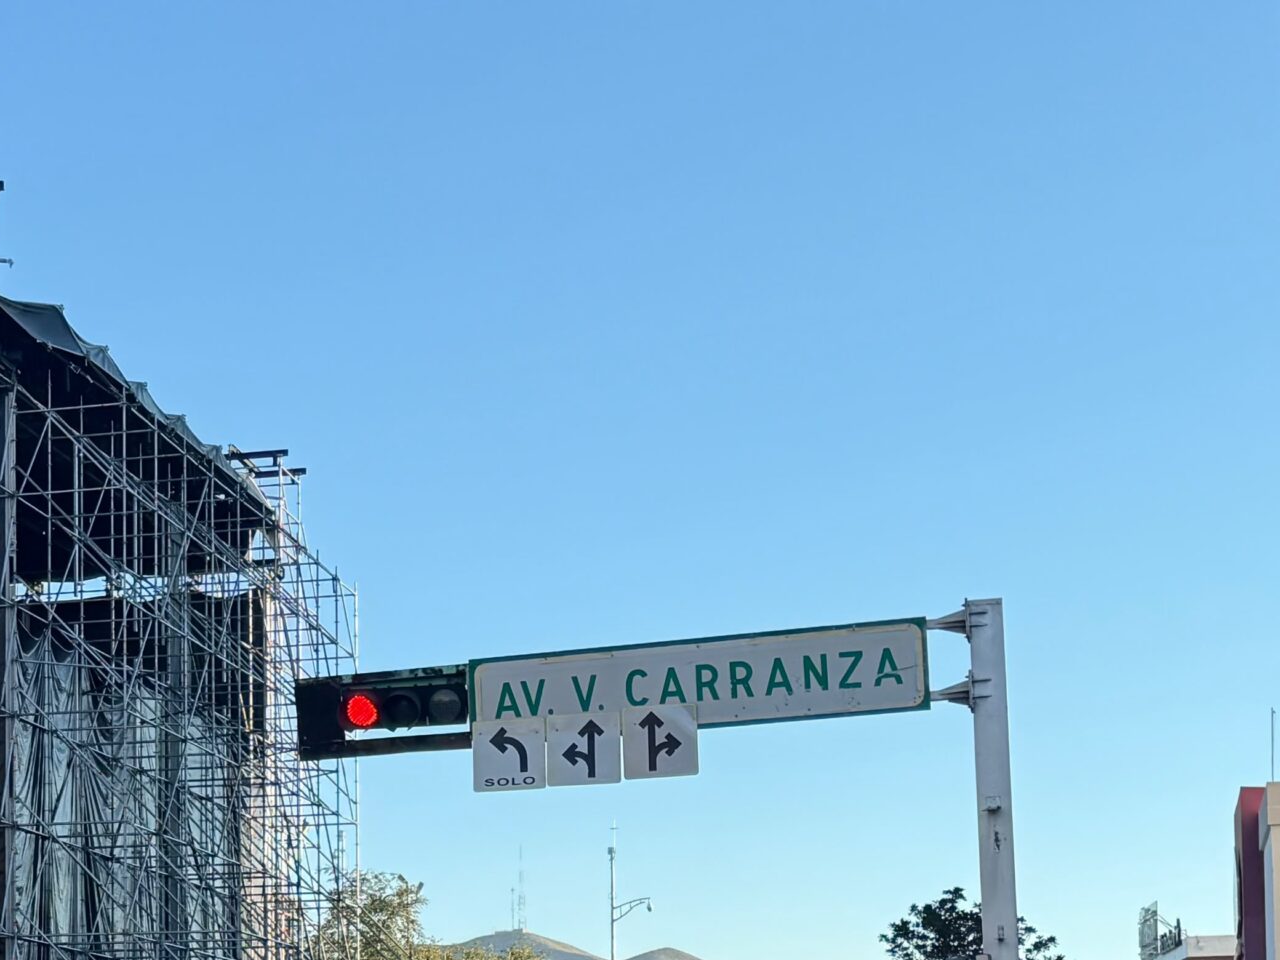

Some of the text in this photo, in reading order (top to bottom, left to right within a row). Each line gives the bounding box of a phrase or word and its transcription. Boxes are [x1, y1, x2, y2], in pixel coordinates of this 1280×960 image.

[494, 647, 903, 720] AV. V. CARRANZA
[484, 776, 536, 788] SOLO
